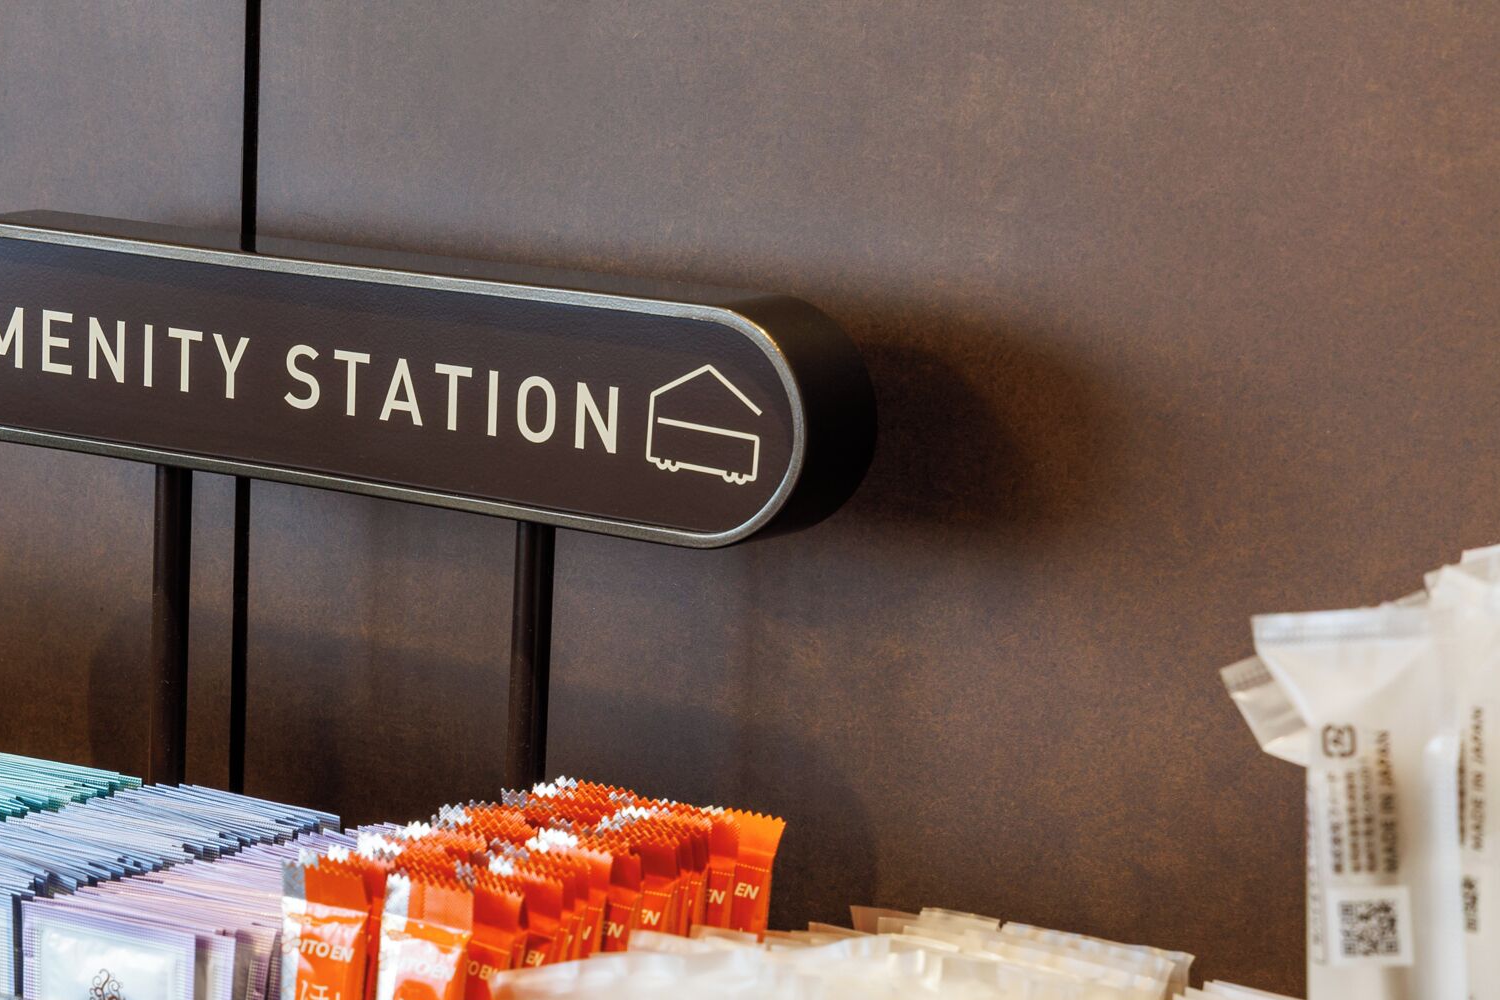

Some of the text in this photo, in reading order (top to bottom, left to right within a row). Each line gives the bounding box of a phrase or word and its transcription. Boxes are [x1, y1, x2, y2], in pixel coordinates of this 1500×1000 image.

[283, 344, 620, 455] STATION
[734, 882, 759, 900] EN
[300, 939, 355, 963] ITO EN
